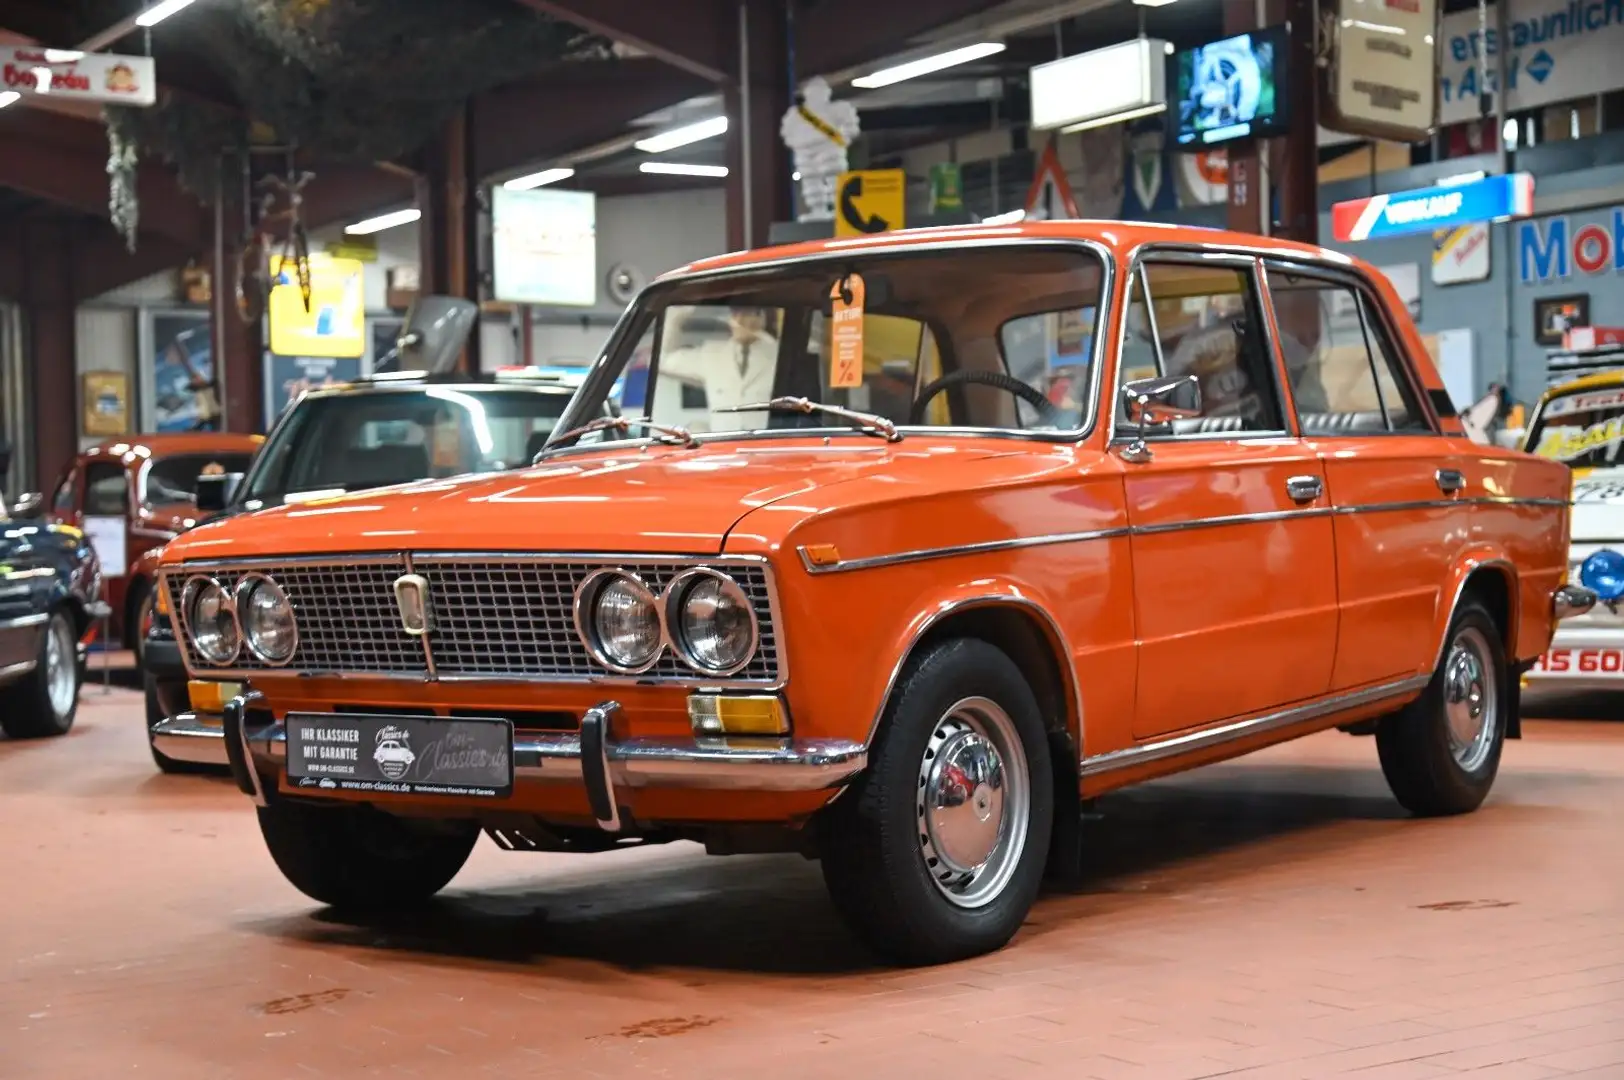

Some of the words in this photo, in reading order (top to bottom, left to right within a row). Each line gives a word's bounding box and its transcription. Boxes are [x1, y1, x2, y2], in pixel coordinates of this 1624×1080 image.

[1451, 0, 1624, 62] ersaunlich
[301, 728, 315, 741] IHR
[316, 729, 360, 743] KLASSIKER
[303, 745, 318, 758] MIT
[319, 746, 359, 761] GARANTIE
[341, 780, 411, 793] www.om-classics.de
